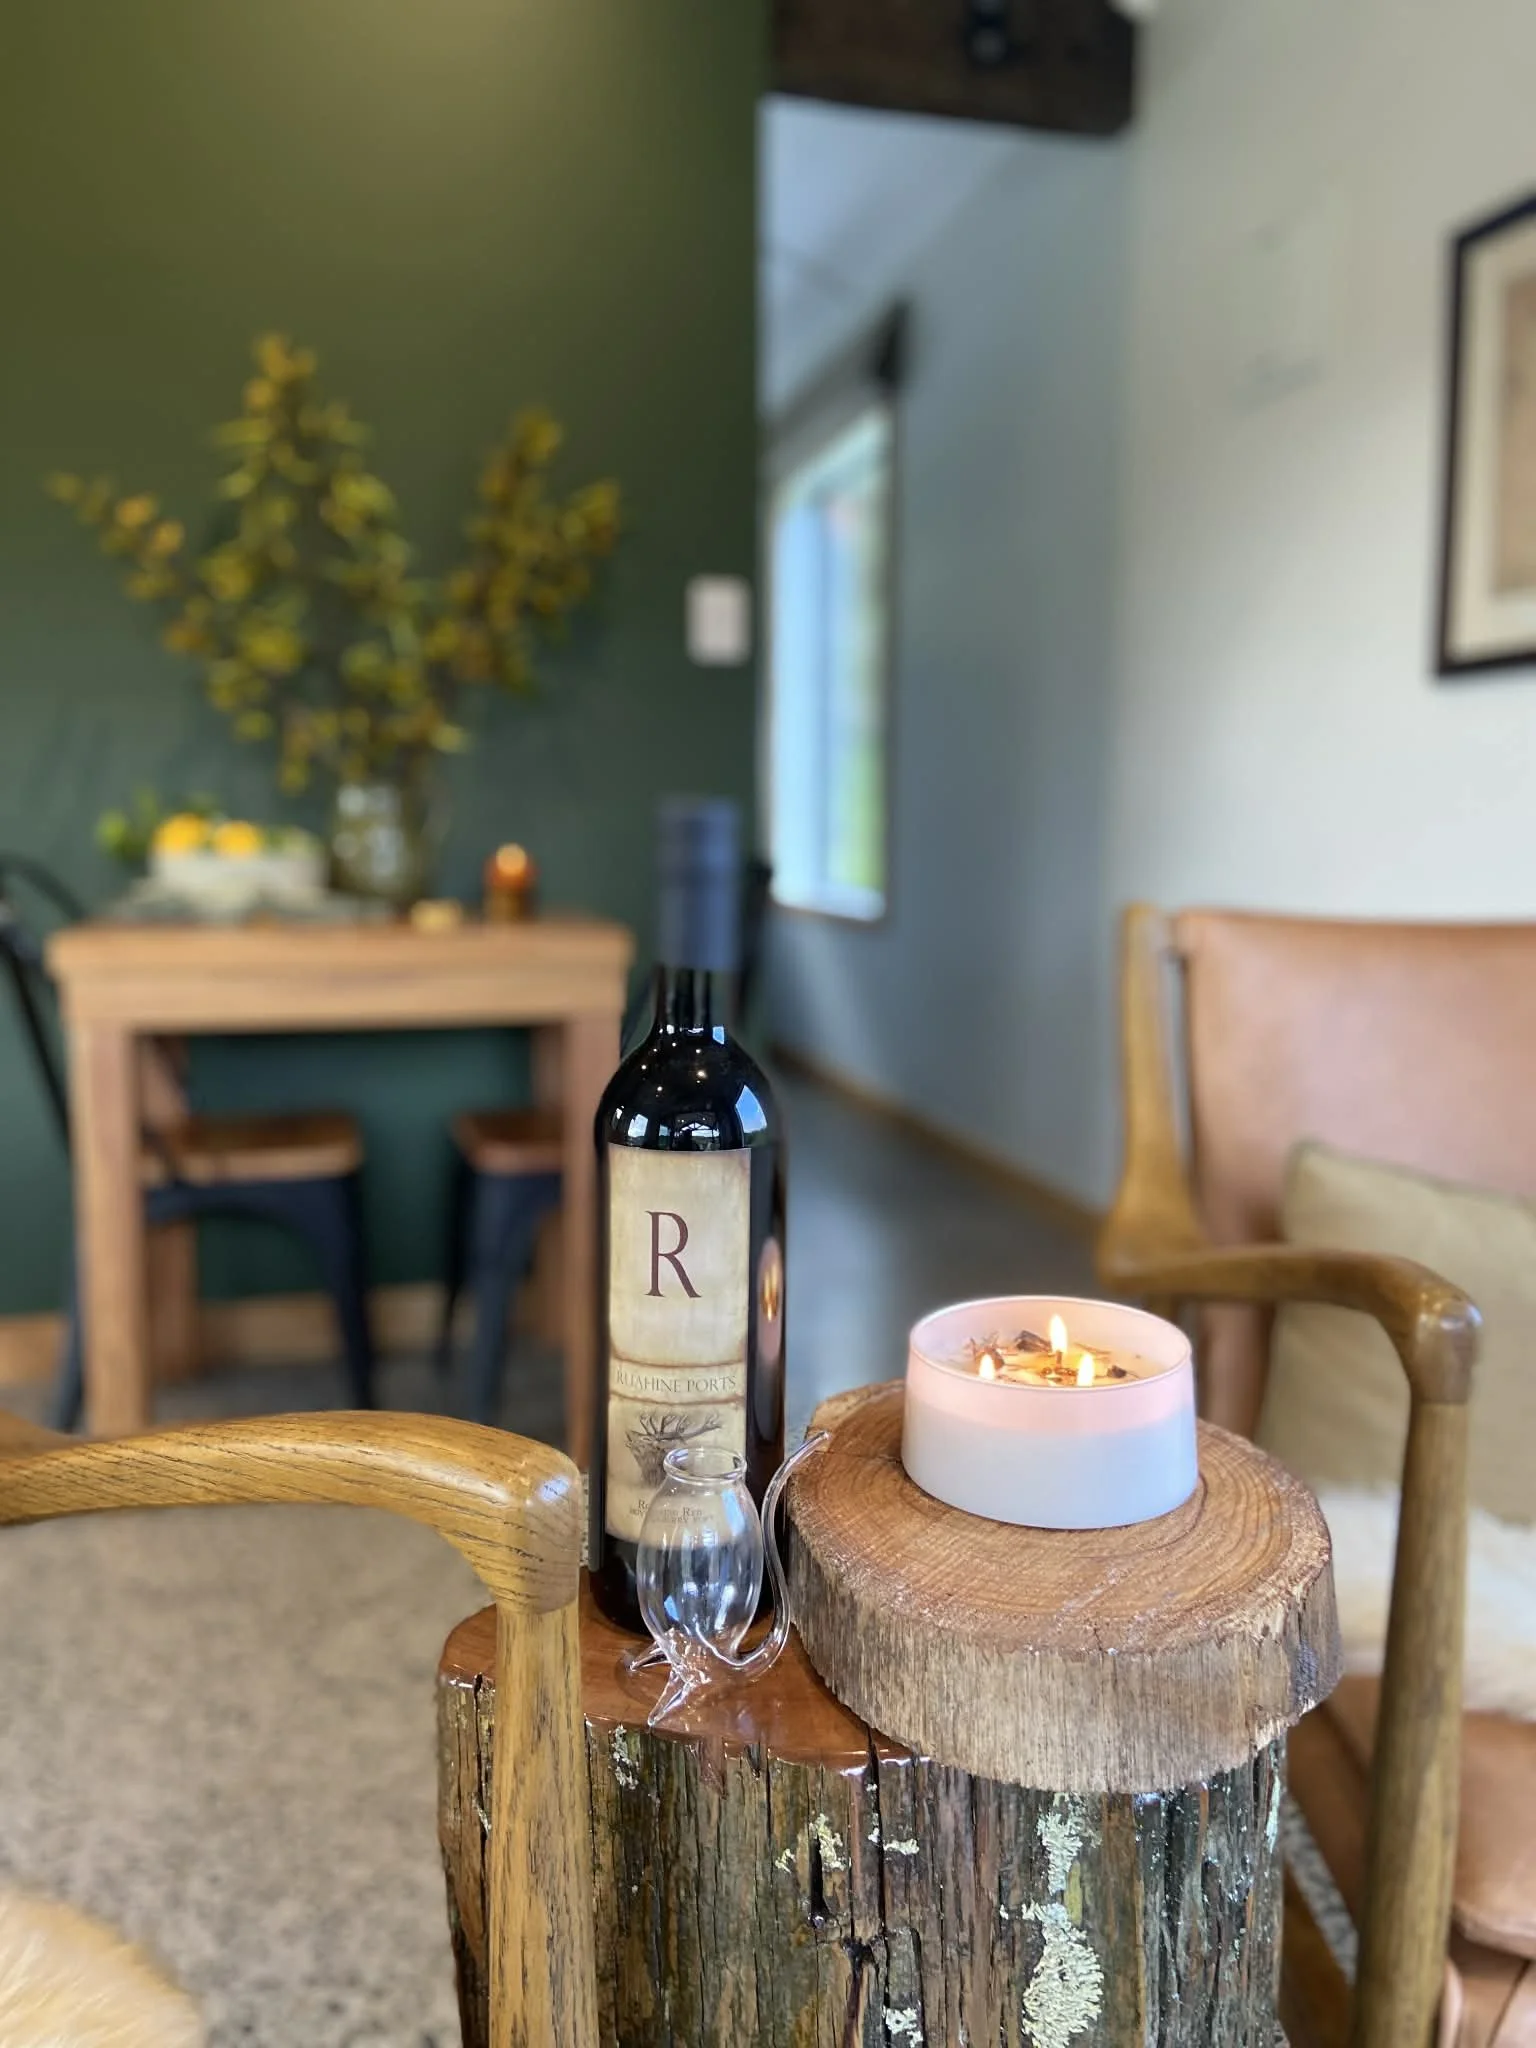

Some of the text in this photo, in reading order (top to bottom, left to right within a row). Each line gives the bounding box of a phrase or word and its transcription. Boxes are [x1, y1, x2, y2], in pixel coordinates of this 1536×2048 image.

[645, 1210, 702, 1298] R
[616, 1369, 737, 1392] RUAHINE PORTS
